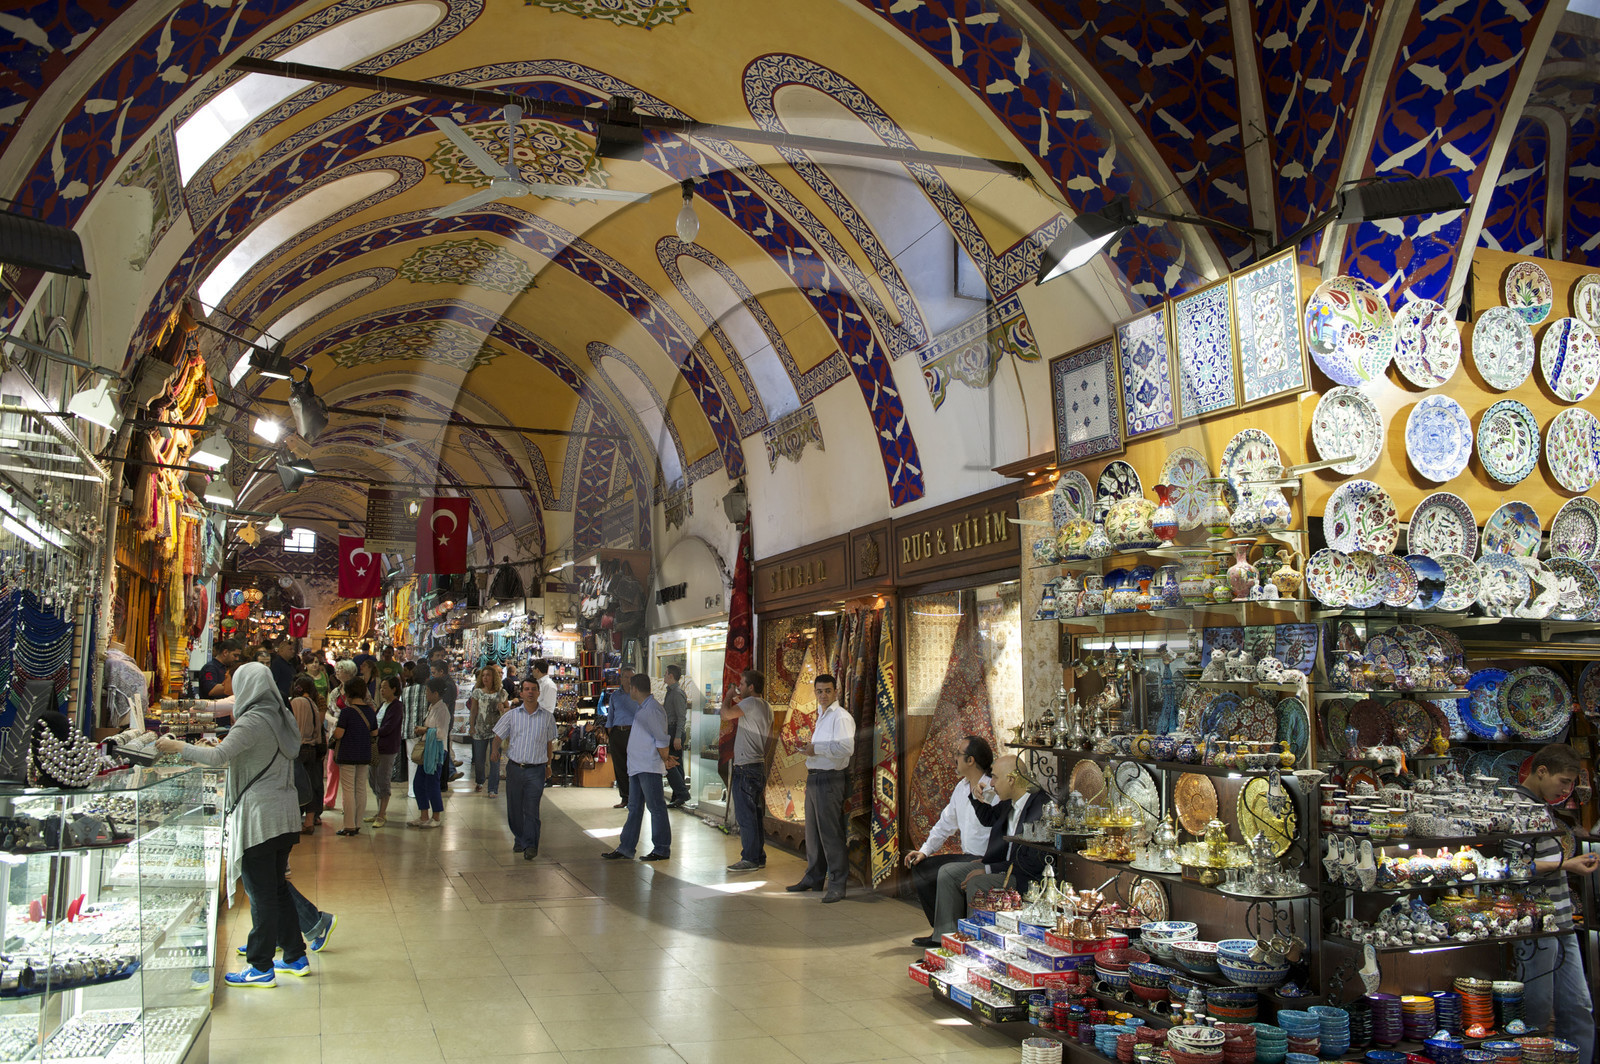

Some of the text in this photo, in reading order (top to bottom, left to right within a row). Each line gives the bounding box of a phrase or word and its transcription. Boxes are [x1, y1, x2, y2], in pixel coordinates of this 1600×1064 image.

[902, 509, 1007, 564] RUG & KİLİM
